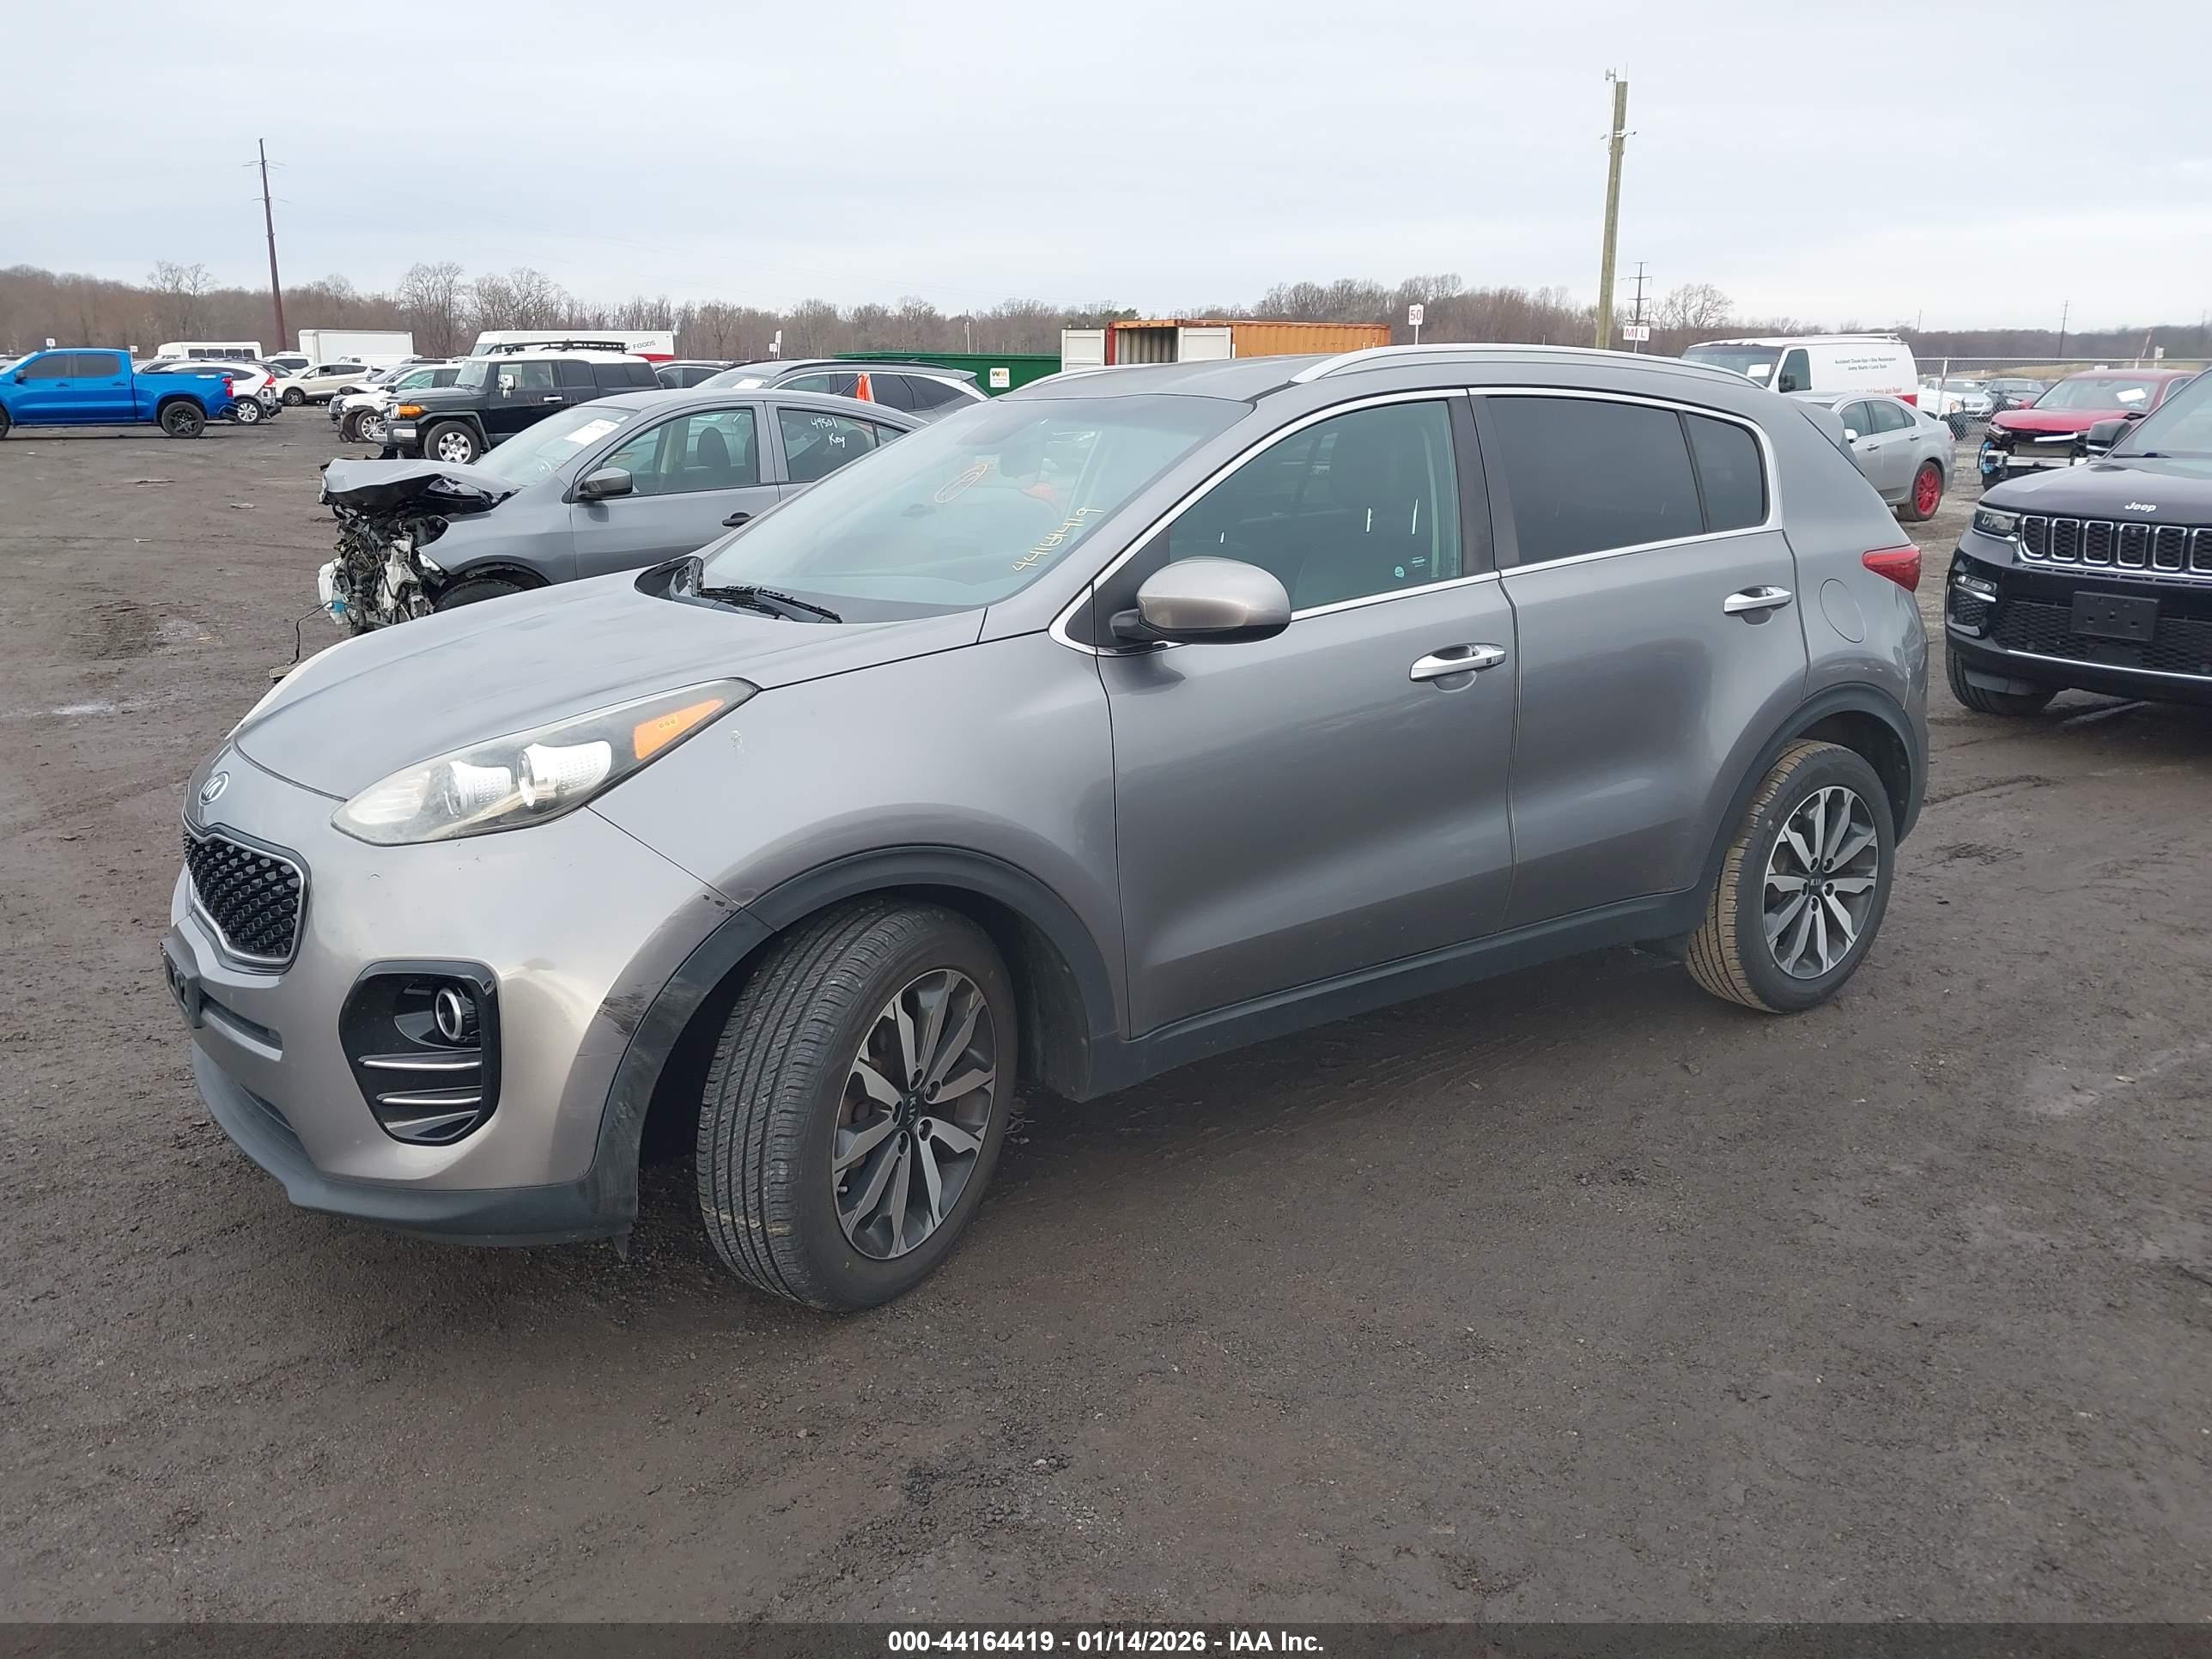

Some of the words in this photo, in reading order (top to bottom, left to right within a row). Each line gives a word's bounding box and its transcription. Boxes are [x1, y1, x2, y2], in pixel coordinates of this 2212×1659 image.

[1410, 309, 1422, 321] 50
[1625, 328, 1635, 337] M
[633, 340, 656, 349] FOODS
[811, 416, 838, 429] 49501
[829, 433, 846, 448] Key
[2124, 501, 2157, 513] Jeep
[1012, 507, 1105, 571] 44164419
